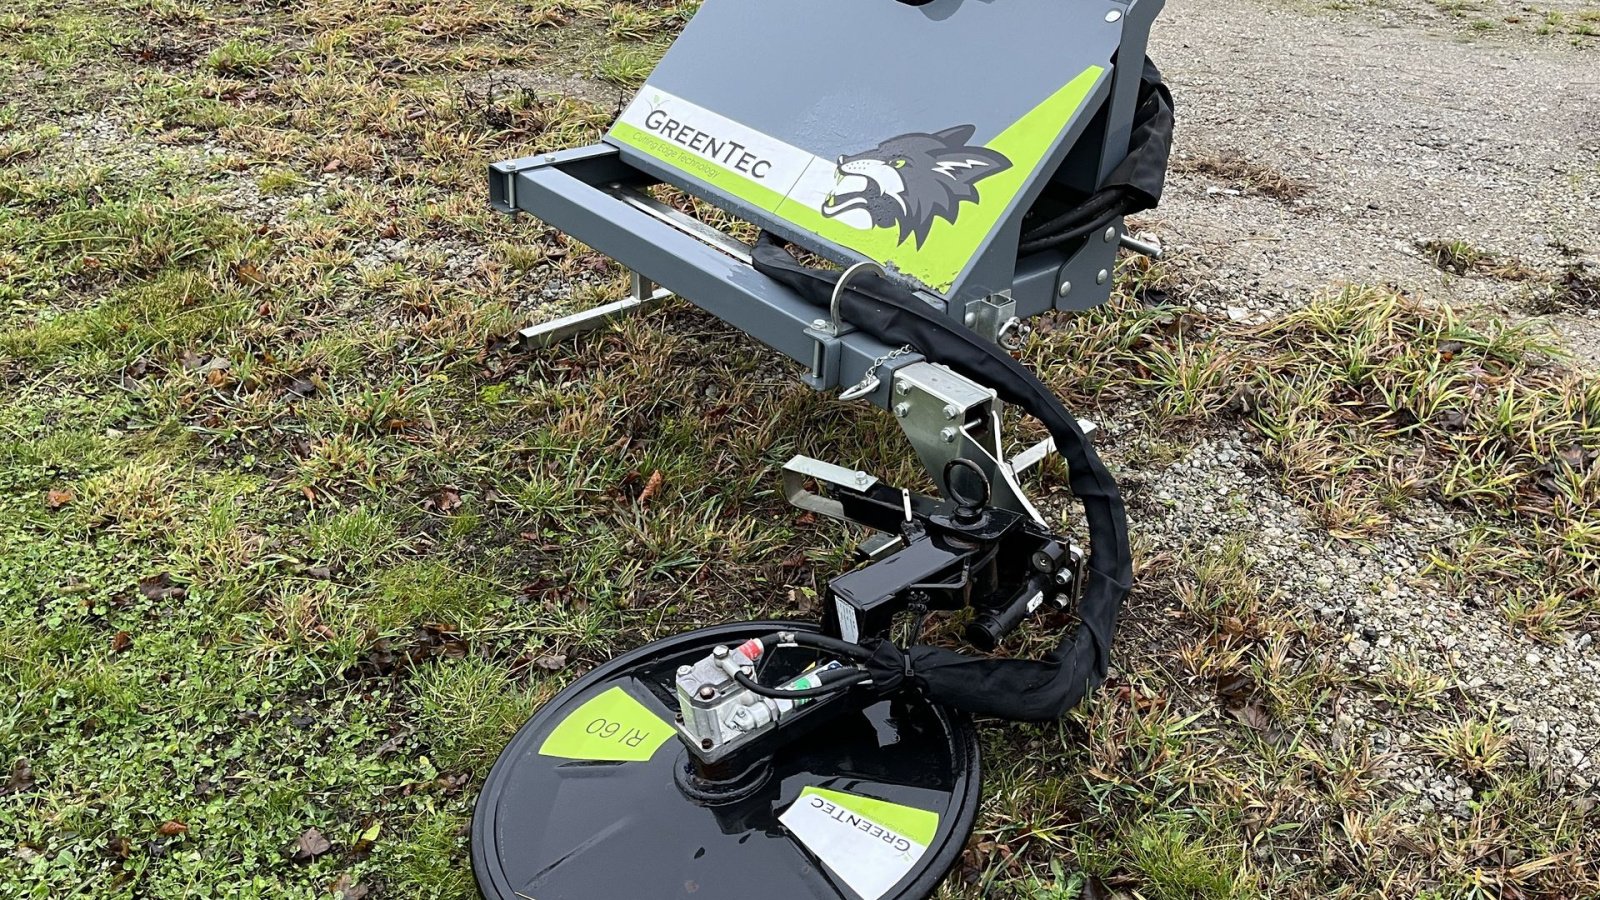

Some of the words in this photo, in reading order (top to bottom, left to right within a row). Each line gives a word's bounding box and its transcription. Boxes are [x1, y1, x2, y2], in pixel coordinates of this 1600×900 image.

[632, 131, 657, 150] Cutting
[657, 143, 676, 158] Edge
[677, 152, 720, 179] Technology
[586, 718, 620, 738] 60
